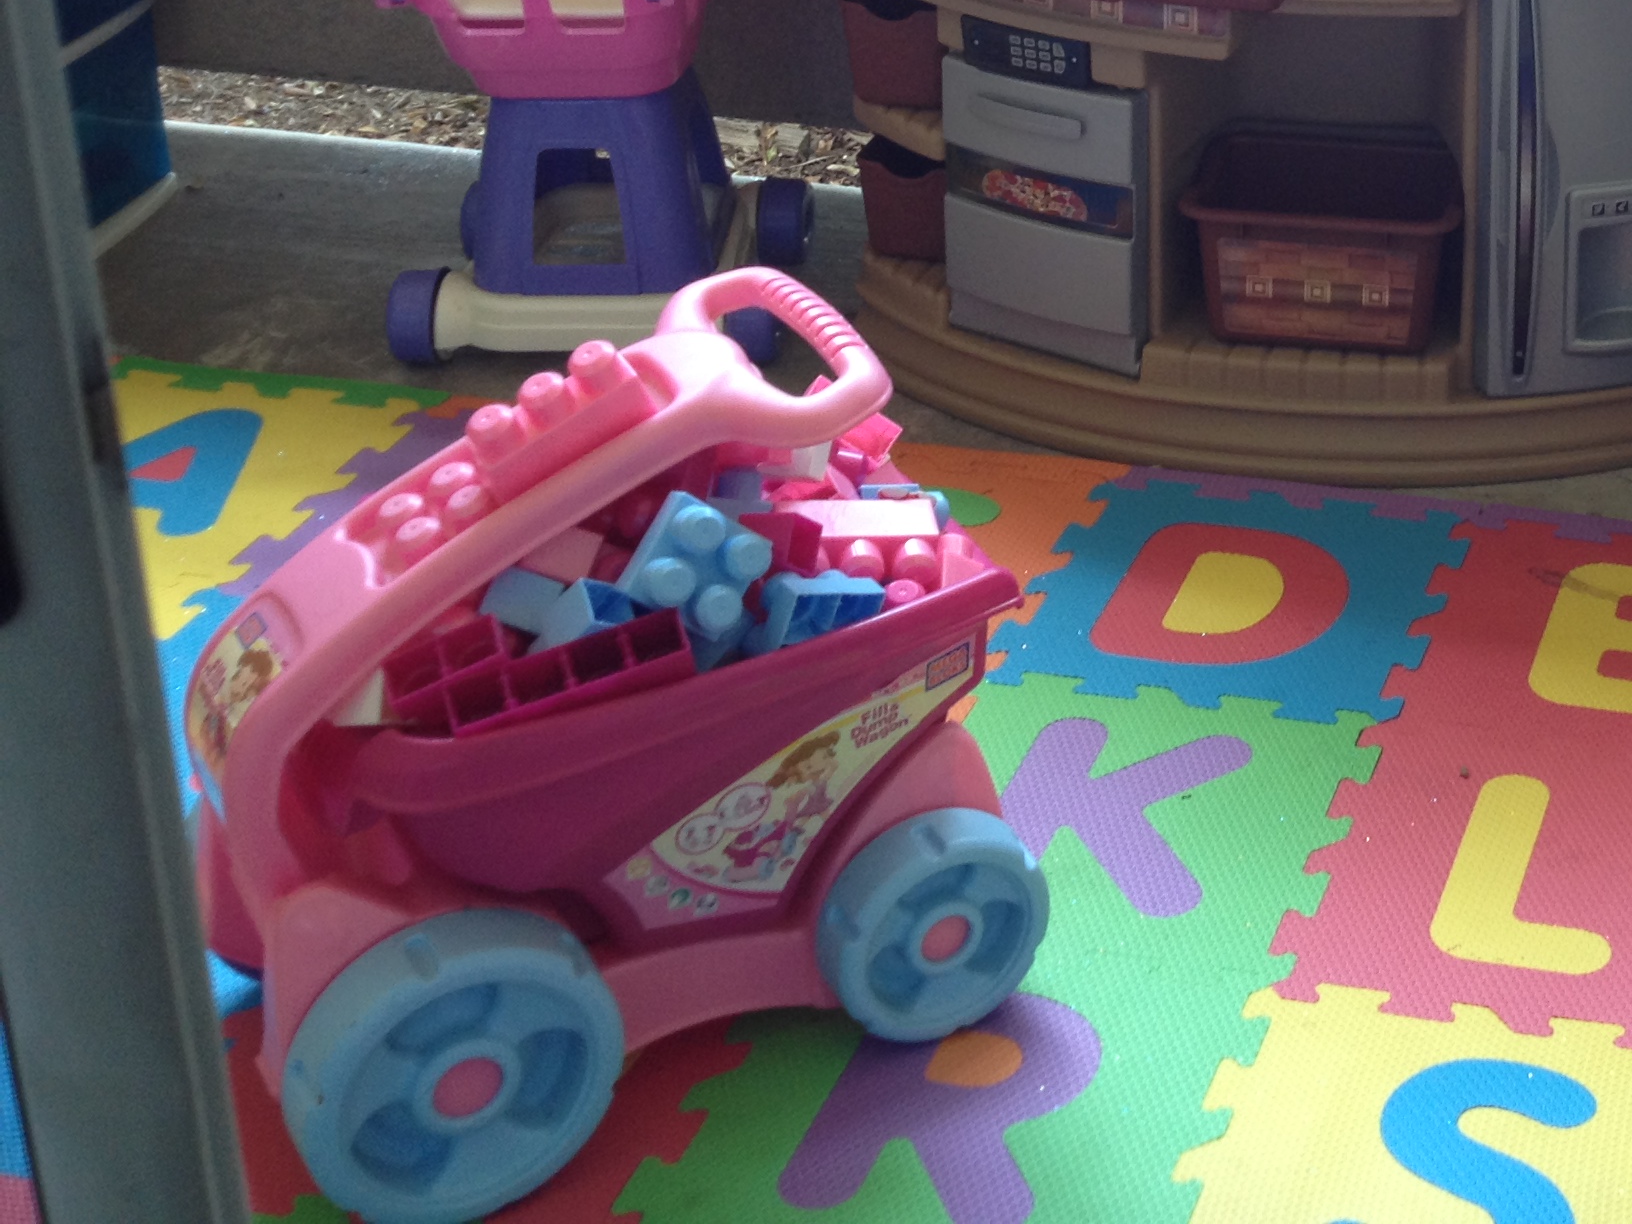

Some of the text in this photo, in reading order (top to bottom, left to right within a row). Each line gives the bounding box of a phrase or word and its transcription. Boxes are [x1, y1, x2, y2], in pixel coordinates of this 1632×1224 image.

[1089, 522, 1350, 664] D
[1000, 717, 1253, 917] K
[1429, 774, 1611, 974] L
[777, 992, 1101, 1224] R
[1322, 1059, 1597, 1224] S
